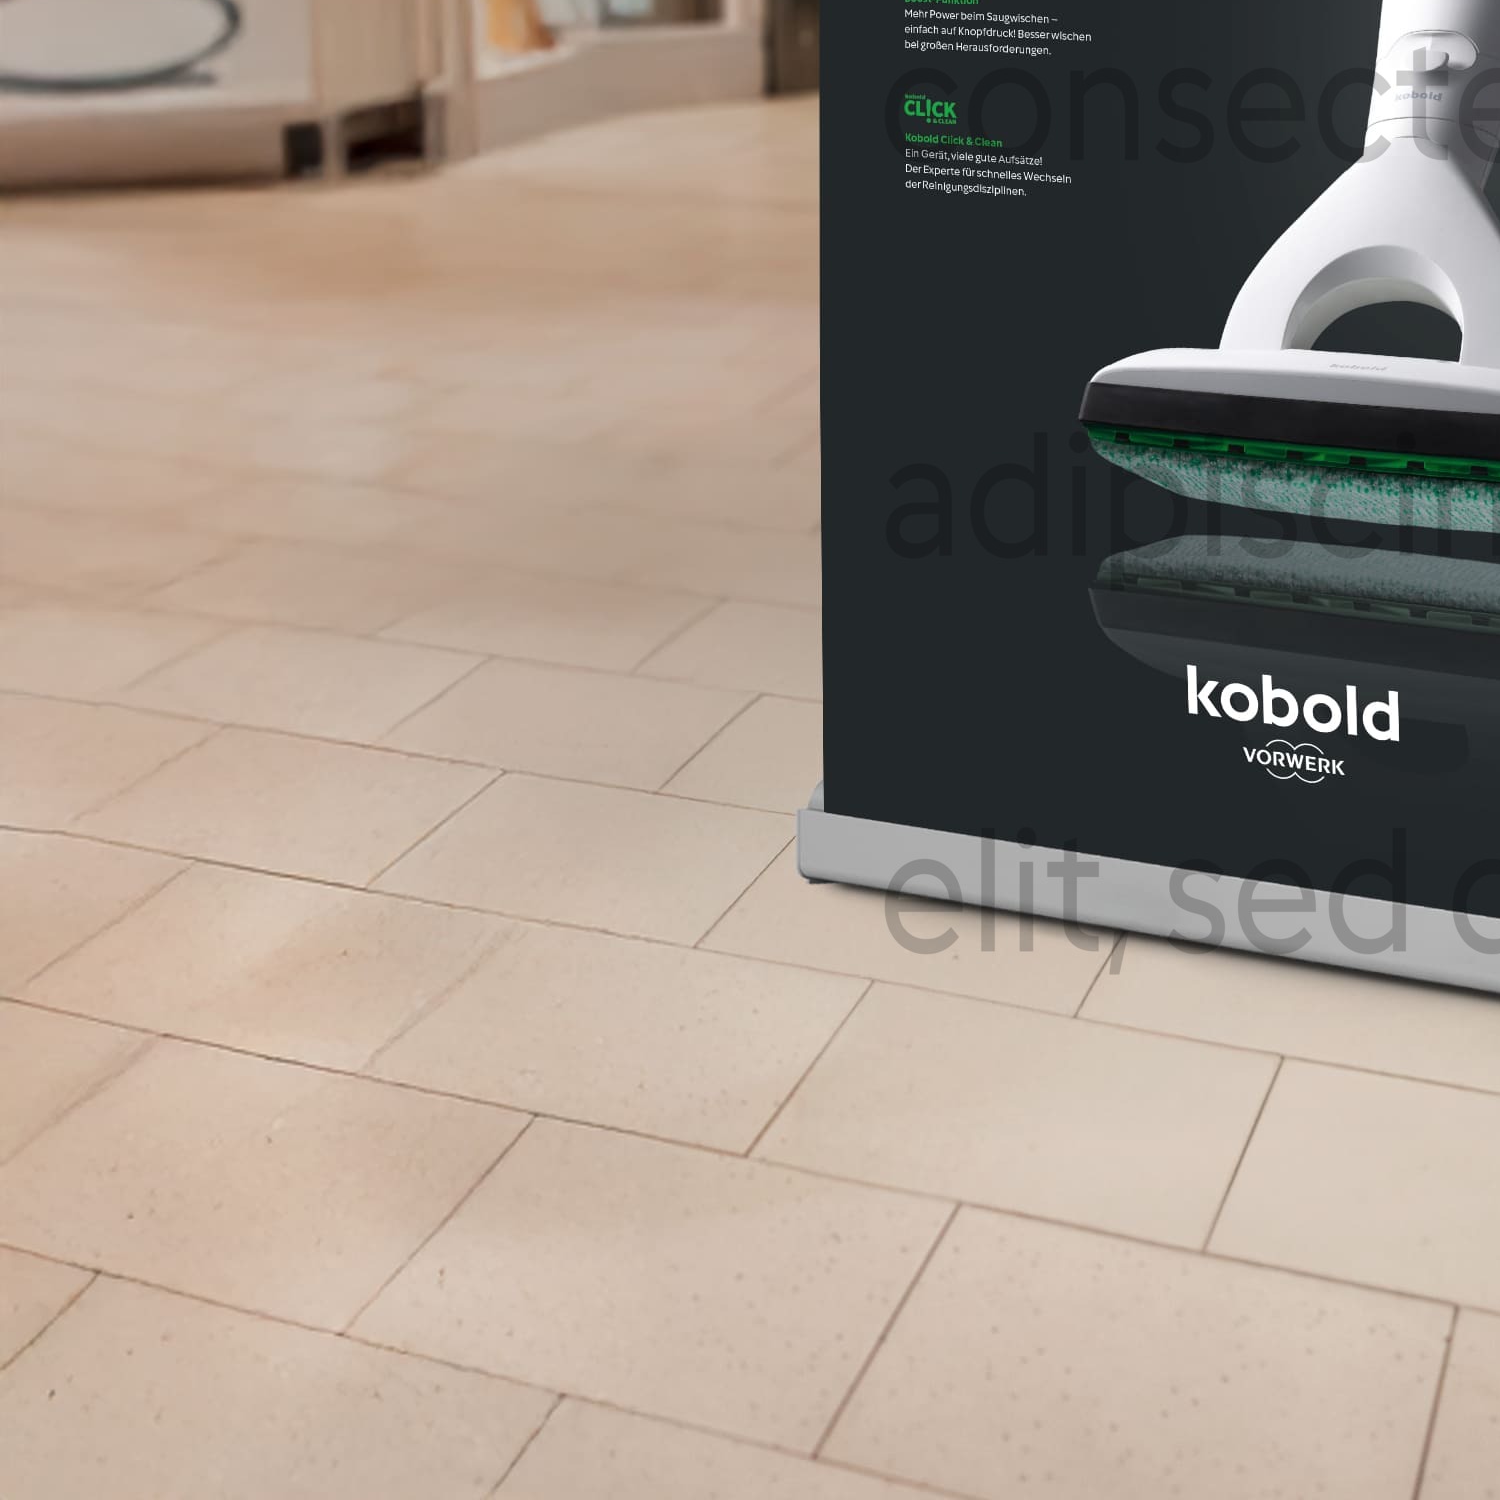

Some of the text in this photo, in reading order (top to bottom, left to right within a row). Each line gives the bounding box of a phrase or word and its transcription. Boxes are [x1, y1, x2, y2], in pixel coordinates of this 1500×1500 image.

[904, 9, 928, 18] Mehr
[929, 9, 959, 20] Power
[960, 11, 985, 20] beim
[986, 12, 1049, 24] Saugwischen
[904, 24, 939, 34] einfach
[941, 26, 957, 35] auf
[958, 26, 1016, 39] Knopfdruck!
[1017, 29, 1050, 39] Besser
[904, 40, 1052, 57] bei großen Herausforderungen.
[905, 132, 1003, 148] Kobold Click & Clean
[905, 148, 1043, 166] Ein Gerät, viele gute Aufsätze!
[905, 163, 1072, 184] Der Experte für schnelles Wechseln
[905, 179, 922, 189] der
[1186, 664, 1400, 742] kobold
[1242, 746, 1345, 776] VORWERK
